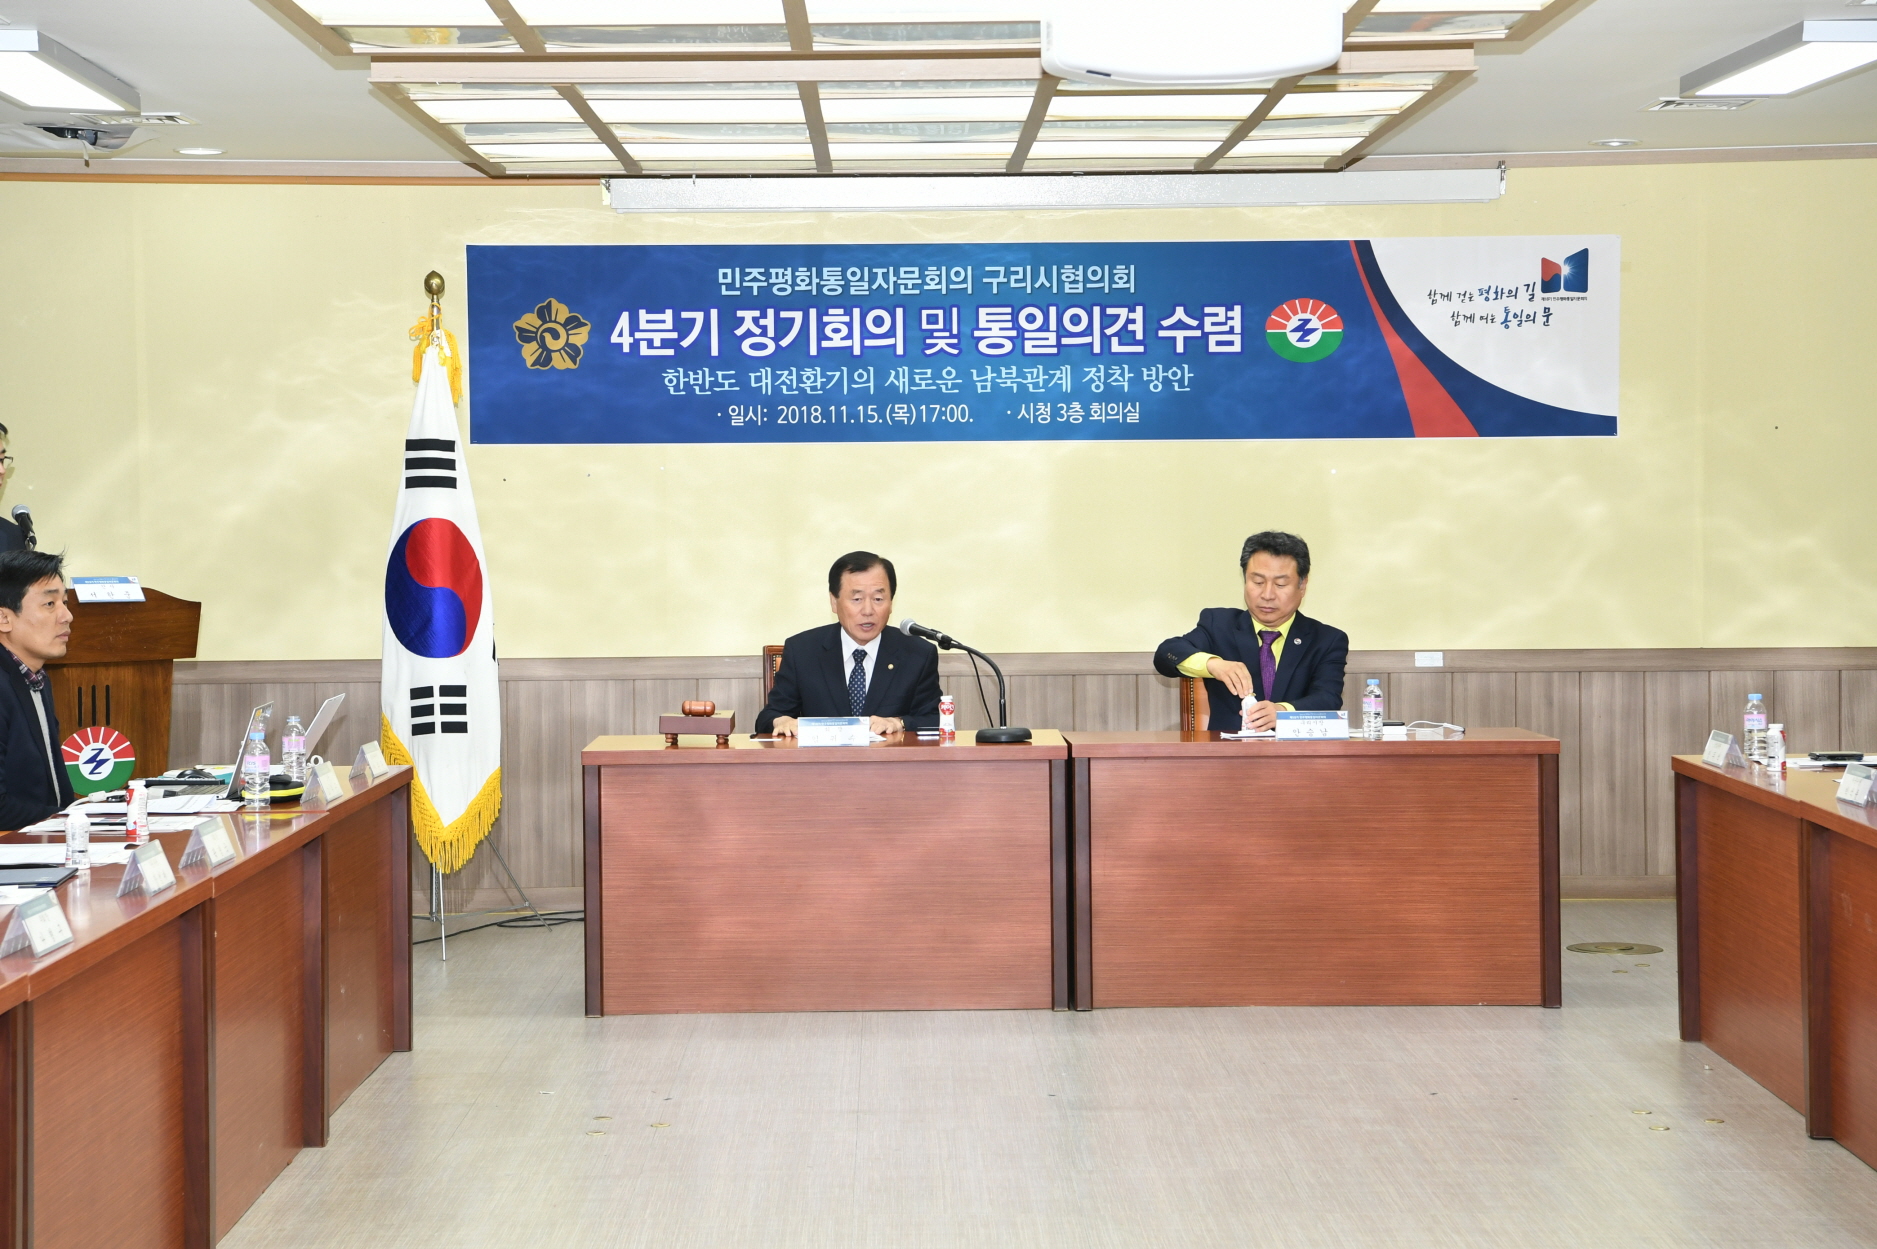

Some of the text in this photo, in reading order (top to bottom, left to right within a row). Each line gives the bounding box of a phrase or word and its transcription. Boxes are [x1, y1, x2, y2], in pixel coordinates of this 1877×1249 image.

[717, 264, 1136, 296] 민주평화통일자문회의 구리시협의회
[1427, 289, 1452, 305] 함께
[1478, 285, 1519, 302] 평화의
[1523, 281, 1536, 302] 길
[1450, 311, 1475, 327] 함께
[1500, 306, 1537, 329] 통일의
[1541, 307, 1553, 326] 문
[609, 304, 1243, 357] 4분기 정기회의 및 통일의견 수렴
[661, 364, 1193, 395] 한반도 대전환기의 새로운 남북관계 정착 방안
[728, 404, 768, 426] 일시:
[1017, 401, 1140, 424] 시청 3층 회의실
